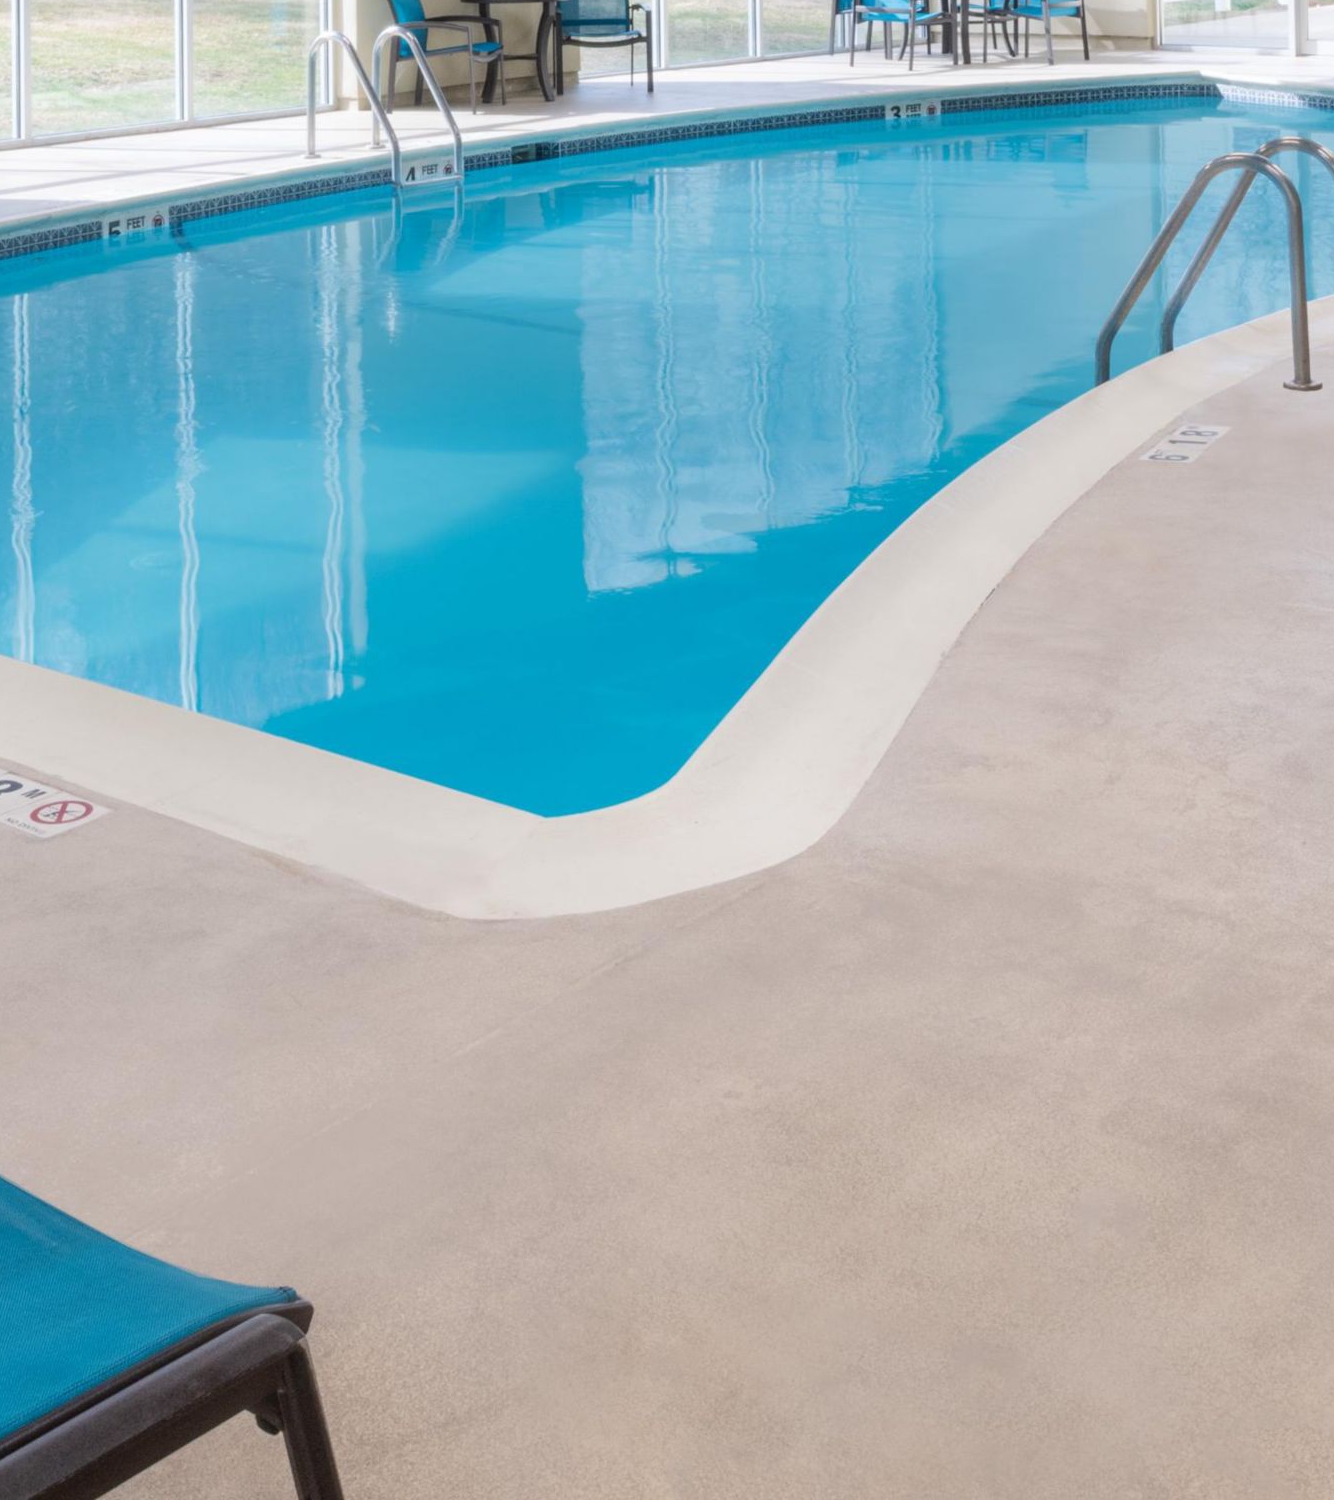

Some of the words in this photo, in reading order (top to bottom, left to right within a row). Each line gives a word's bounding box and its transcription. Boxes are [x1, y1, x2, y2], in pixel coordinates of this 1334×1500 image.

[890, 105, 901, 118] 3
[905, 103, 922, 113] FEET
[421, 163, 438, 176] FEET
[126, 216, 145, 230] FEET
[21, 787, 46, 799] M
